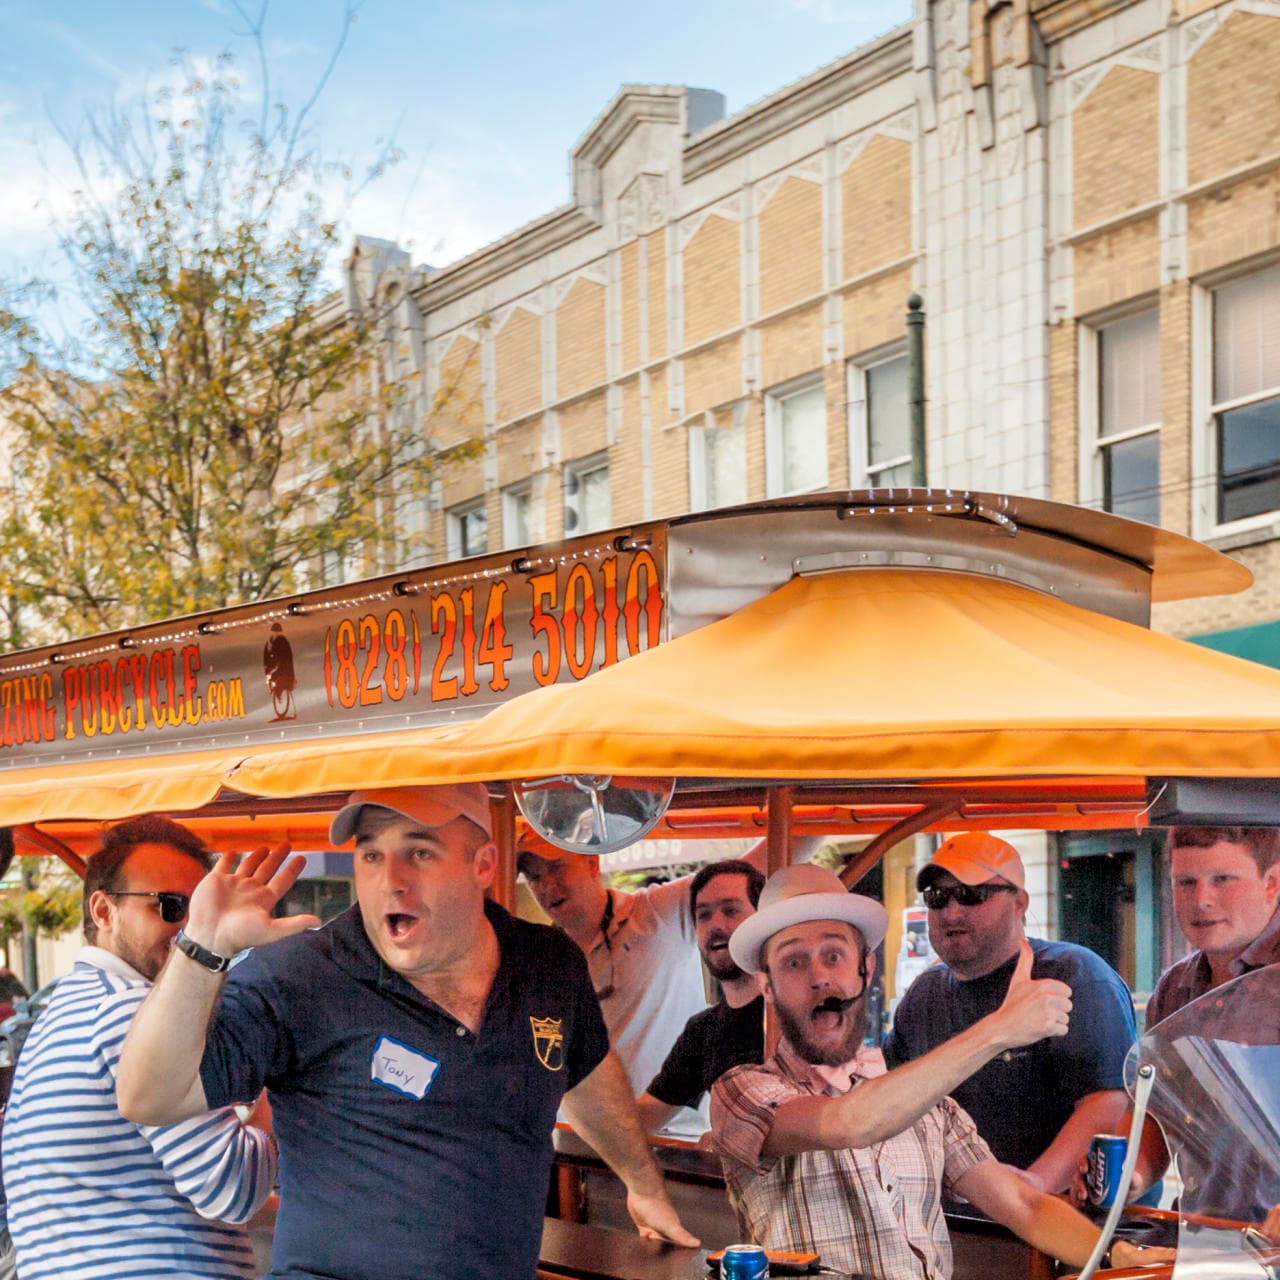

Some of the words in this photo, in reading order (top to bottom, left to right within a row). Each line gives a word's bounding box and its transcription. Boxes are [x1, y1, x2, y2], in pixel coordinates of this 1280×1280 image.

[323, 607, 422, 709] (828)
[430, 579, 514, 703] 214
[526, 549, 664, 688] 5010
